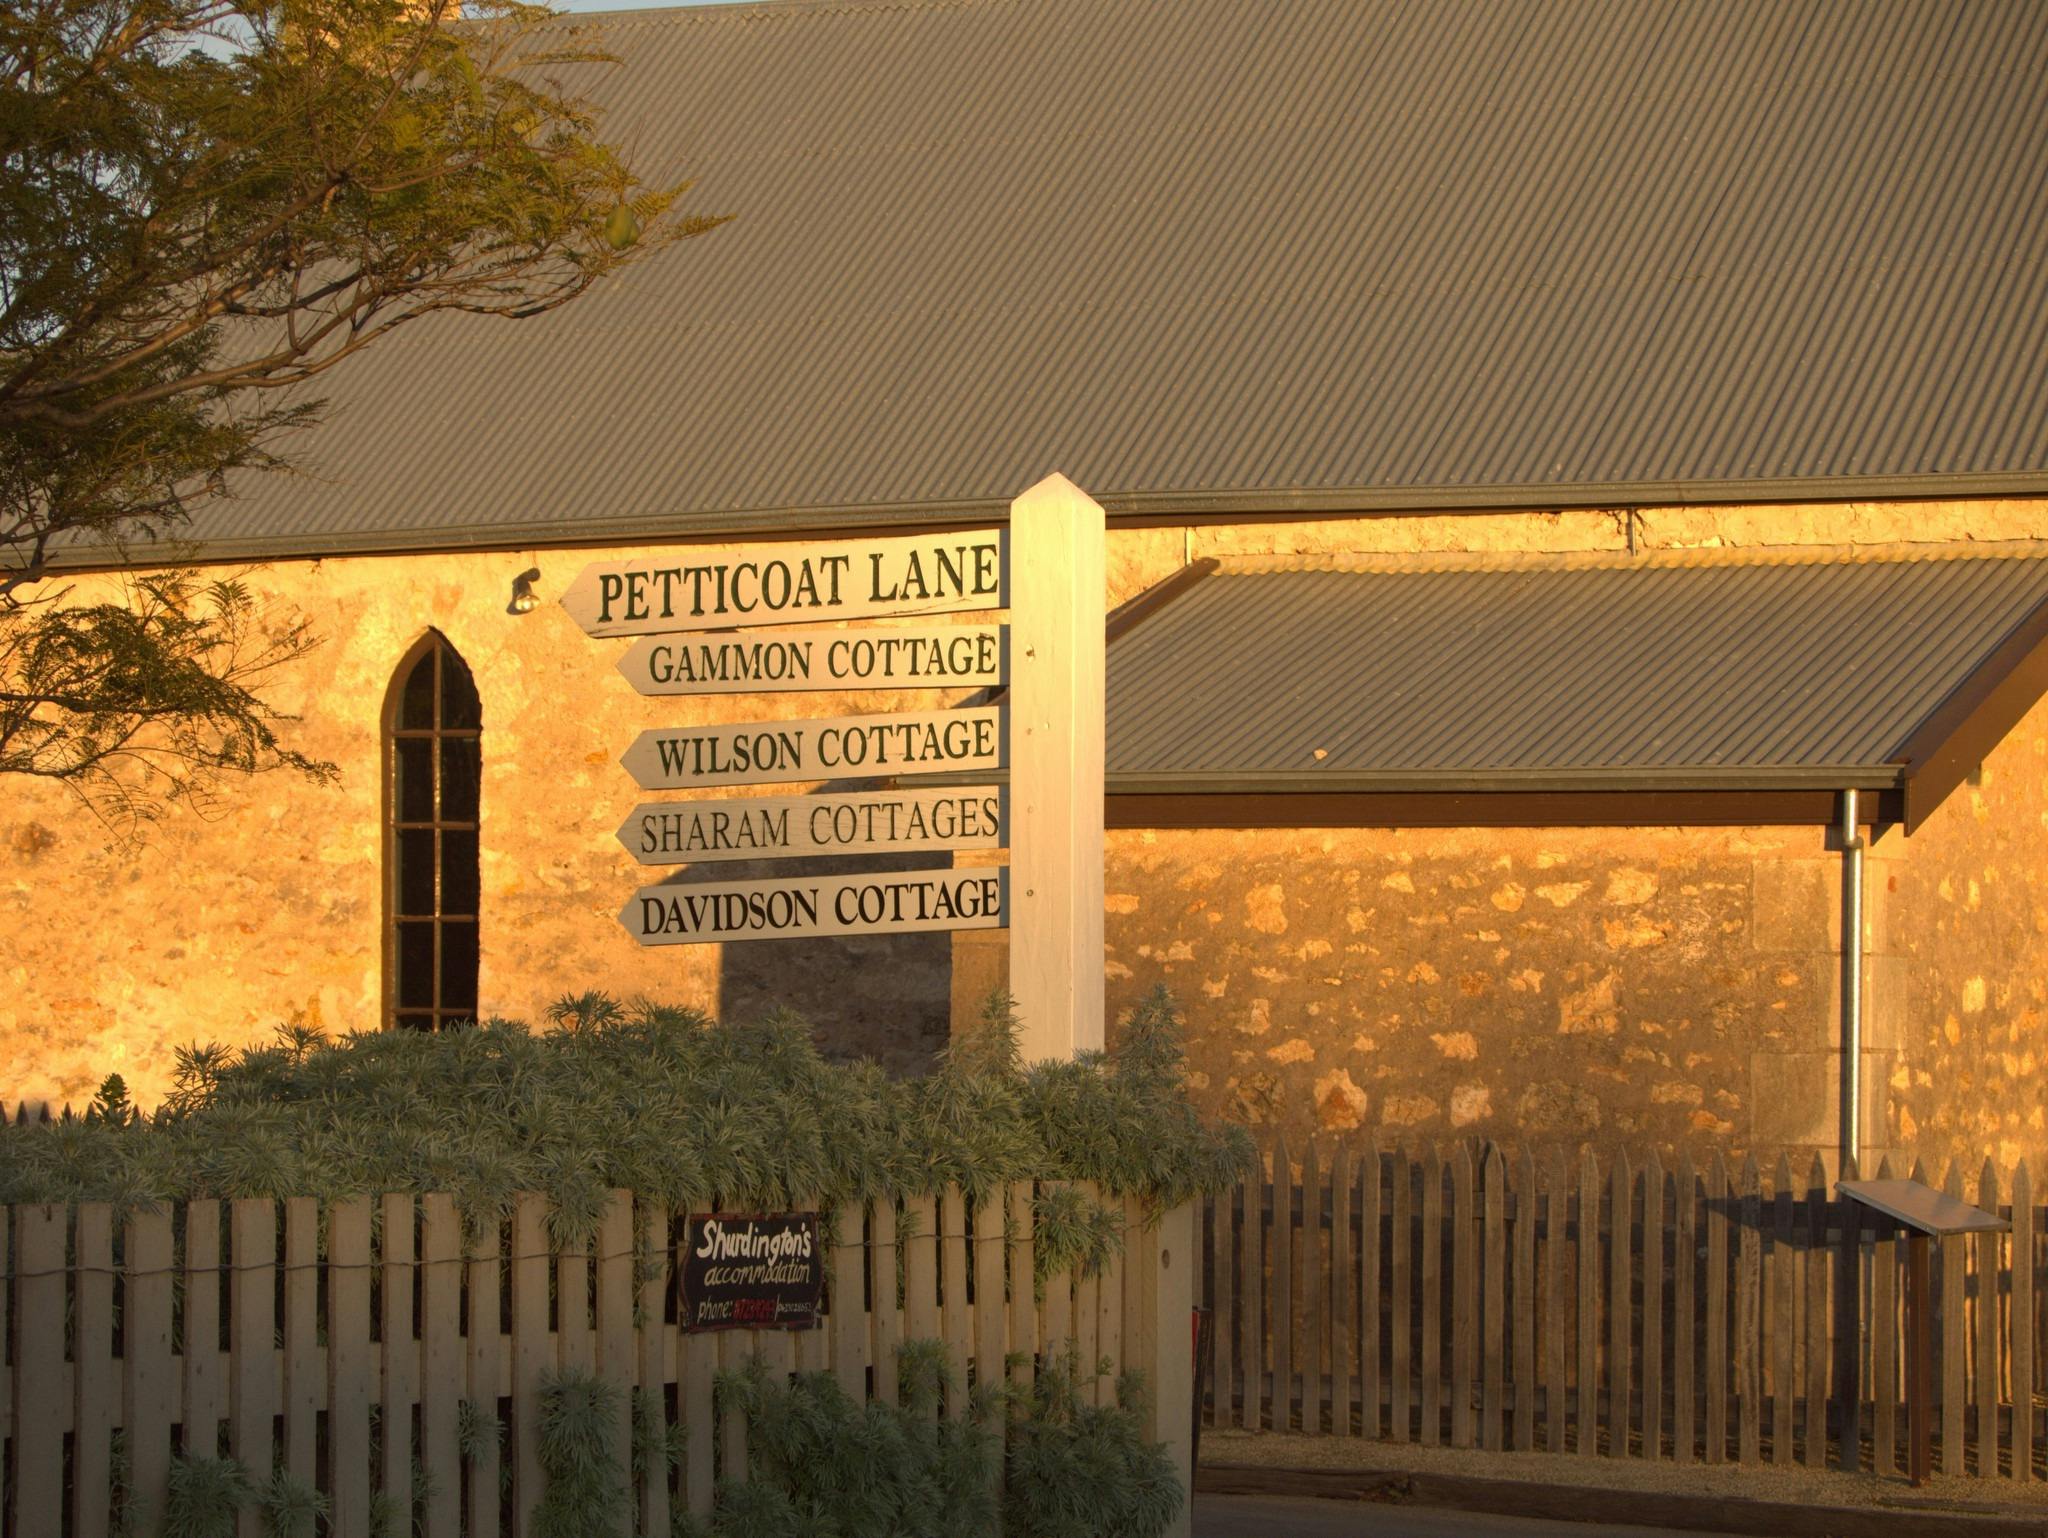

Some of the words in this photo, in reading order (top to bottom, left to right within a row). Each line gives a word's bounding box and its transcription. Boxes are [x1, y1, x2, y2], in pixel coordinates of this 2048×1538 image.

[598, 554, 850, 624] PETTICOAT
[868, 544, 998, 602] LANE
[648, 642, 812, 683] GAMMON
[827, 635, 997, 678] COTTAGE
[656, 731, 804, 777] WILSON
[817, 719, 995, 767] COTTAGE
[641, 808, 789, 854] SHARAM
[810, 797, 999, 844] COTTAGES
[640, 888, 818, 936] DAVIDSON
[834, 878, 1001, 923] COTTAGE
[696, 1219, 811, 1266] Shurdington's
